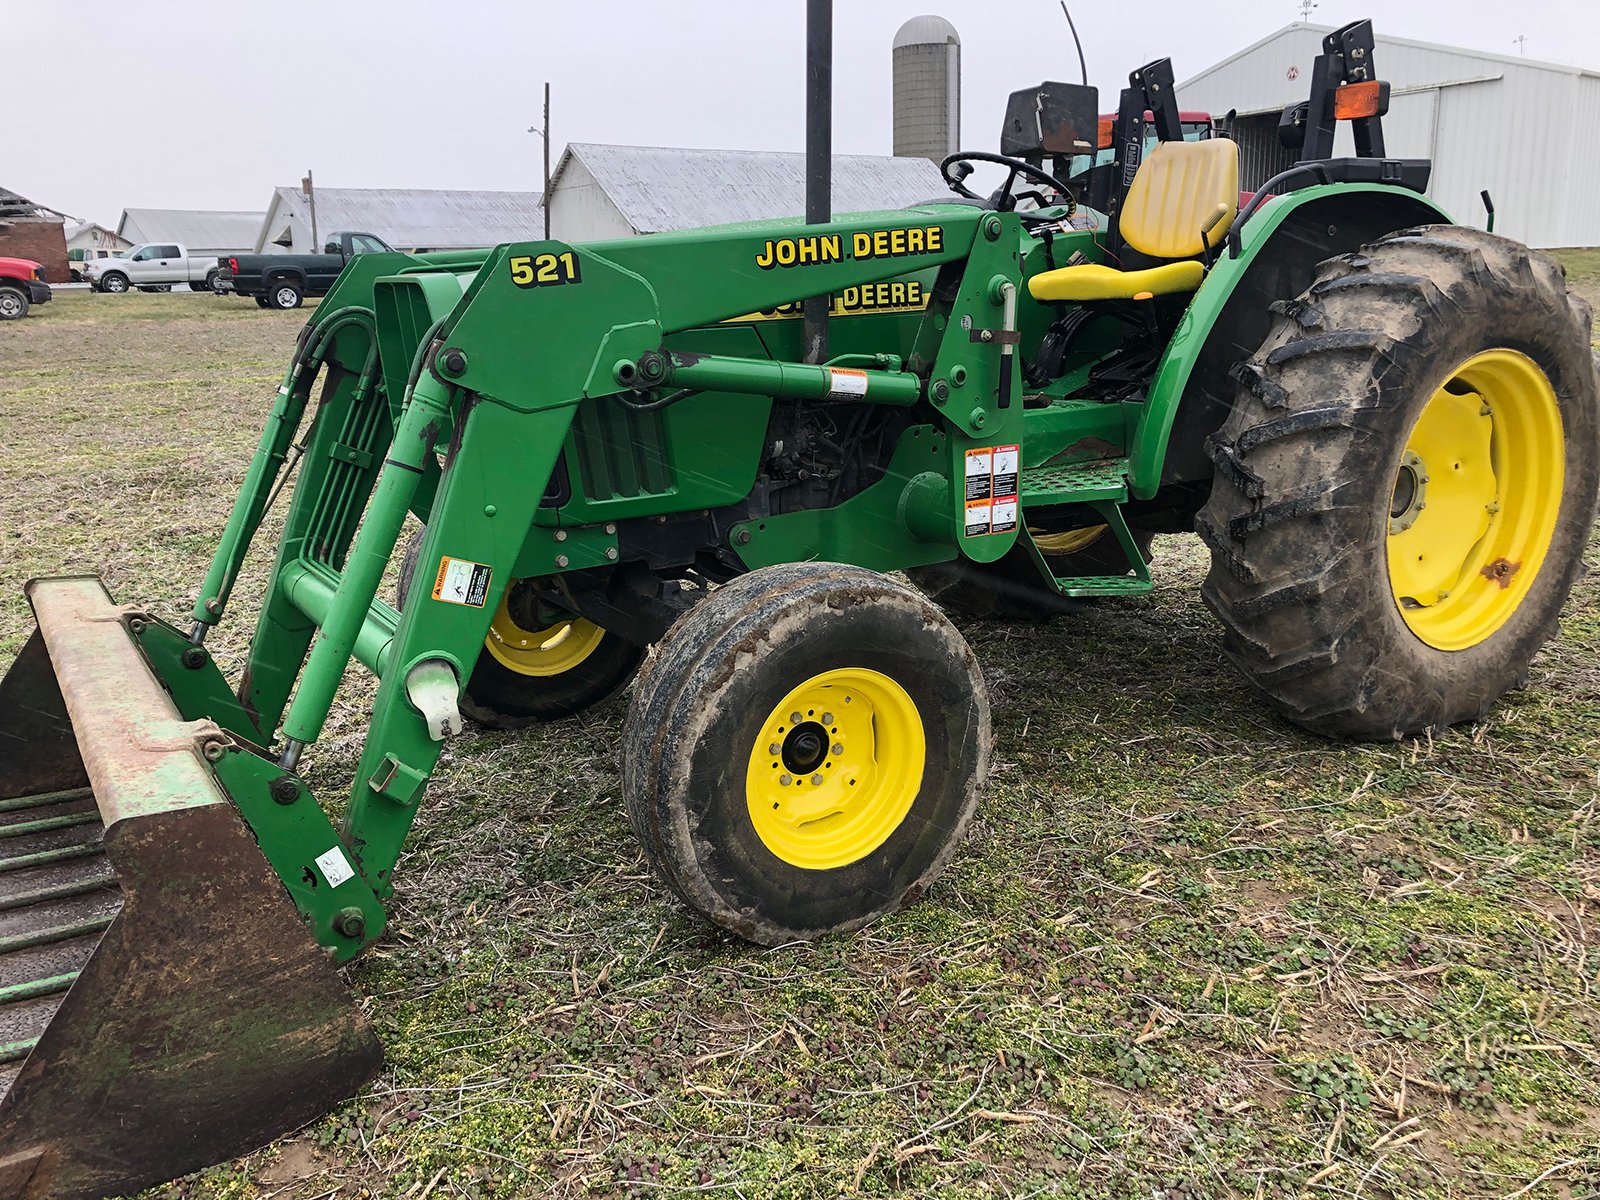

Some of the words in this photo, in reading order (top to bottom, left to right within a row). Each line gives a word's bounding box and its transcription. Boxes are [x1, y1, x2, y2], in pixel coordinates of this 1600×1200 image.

[756, 235, 842, 268] JOHN
[853, 227, 943, 259] DEERE
[510, 252, 578, 287] 521
[843, 281, 921, 308] DEERE
[437, 560, 448, 587] WARNING
